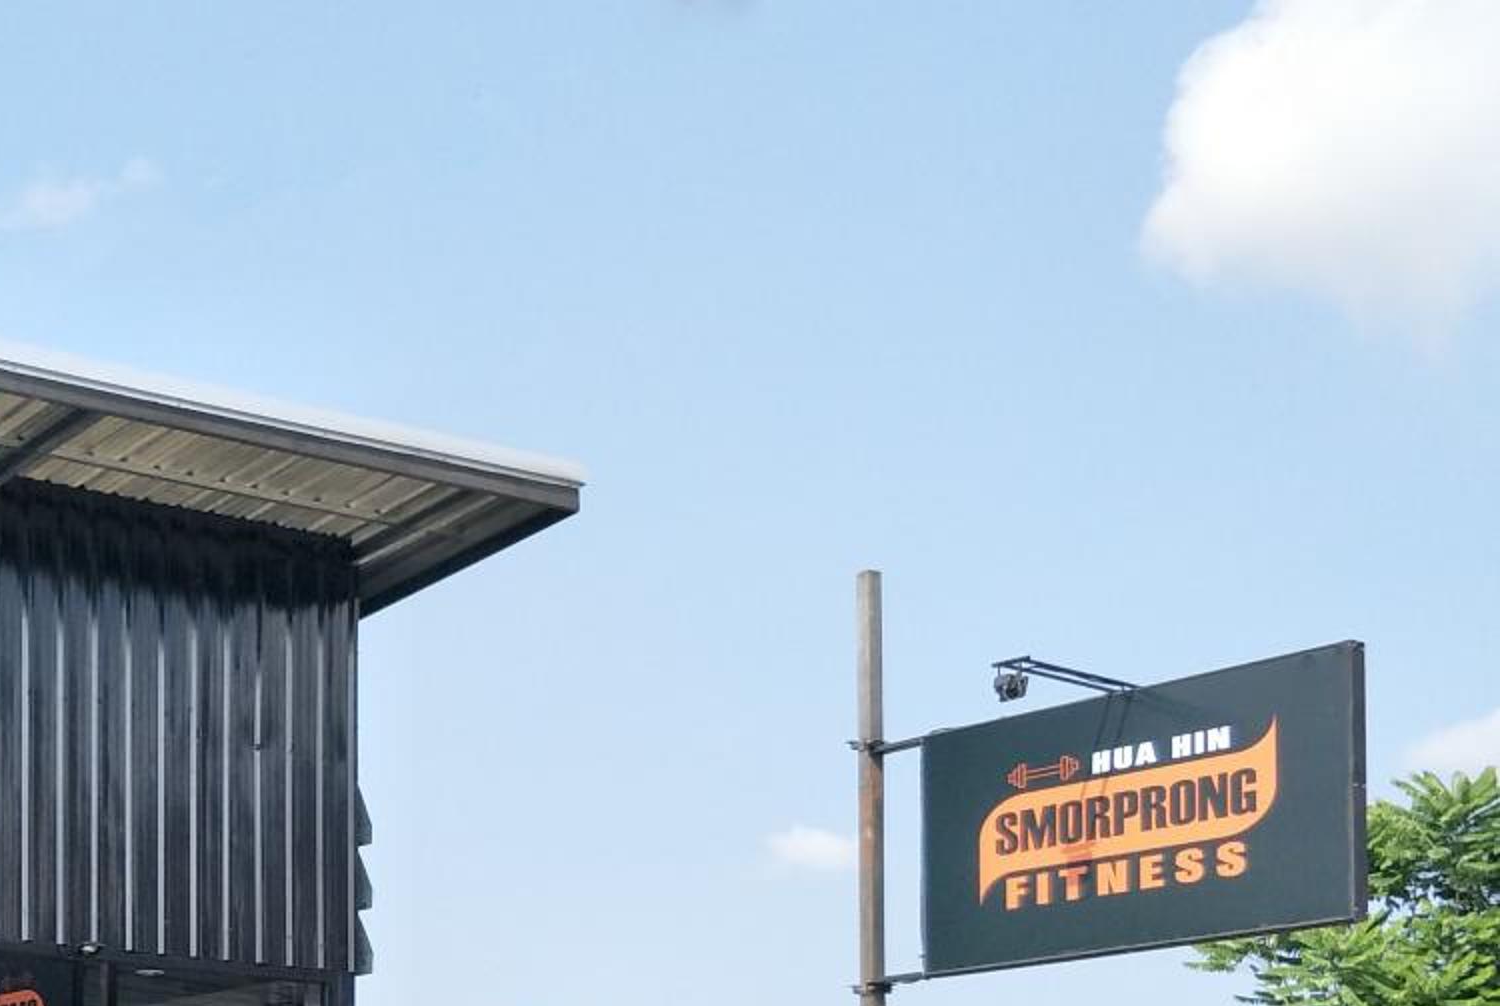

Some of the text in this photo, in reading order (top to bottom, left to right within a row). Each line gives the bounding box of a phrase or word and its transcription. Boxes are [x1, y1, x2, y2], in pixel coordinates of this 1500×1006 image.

[1091, 725, 1231, 775] HUA HIN
[995, 768, 1258, 857] SMORPRONG
[1005, 842, 1248, 911] FITNESS
